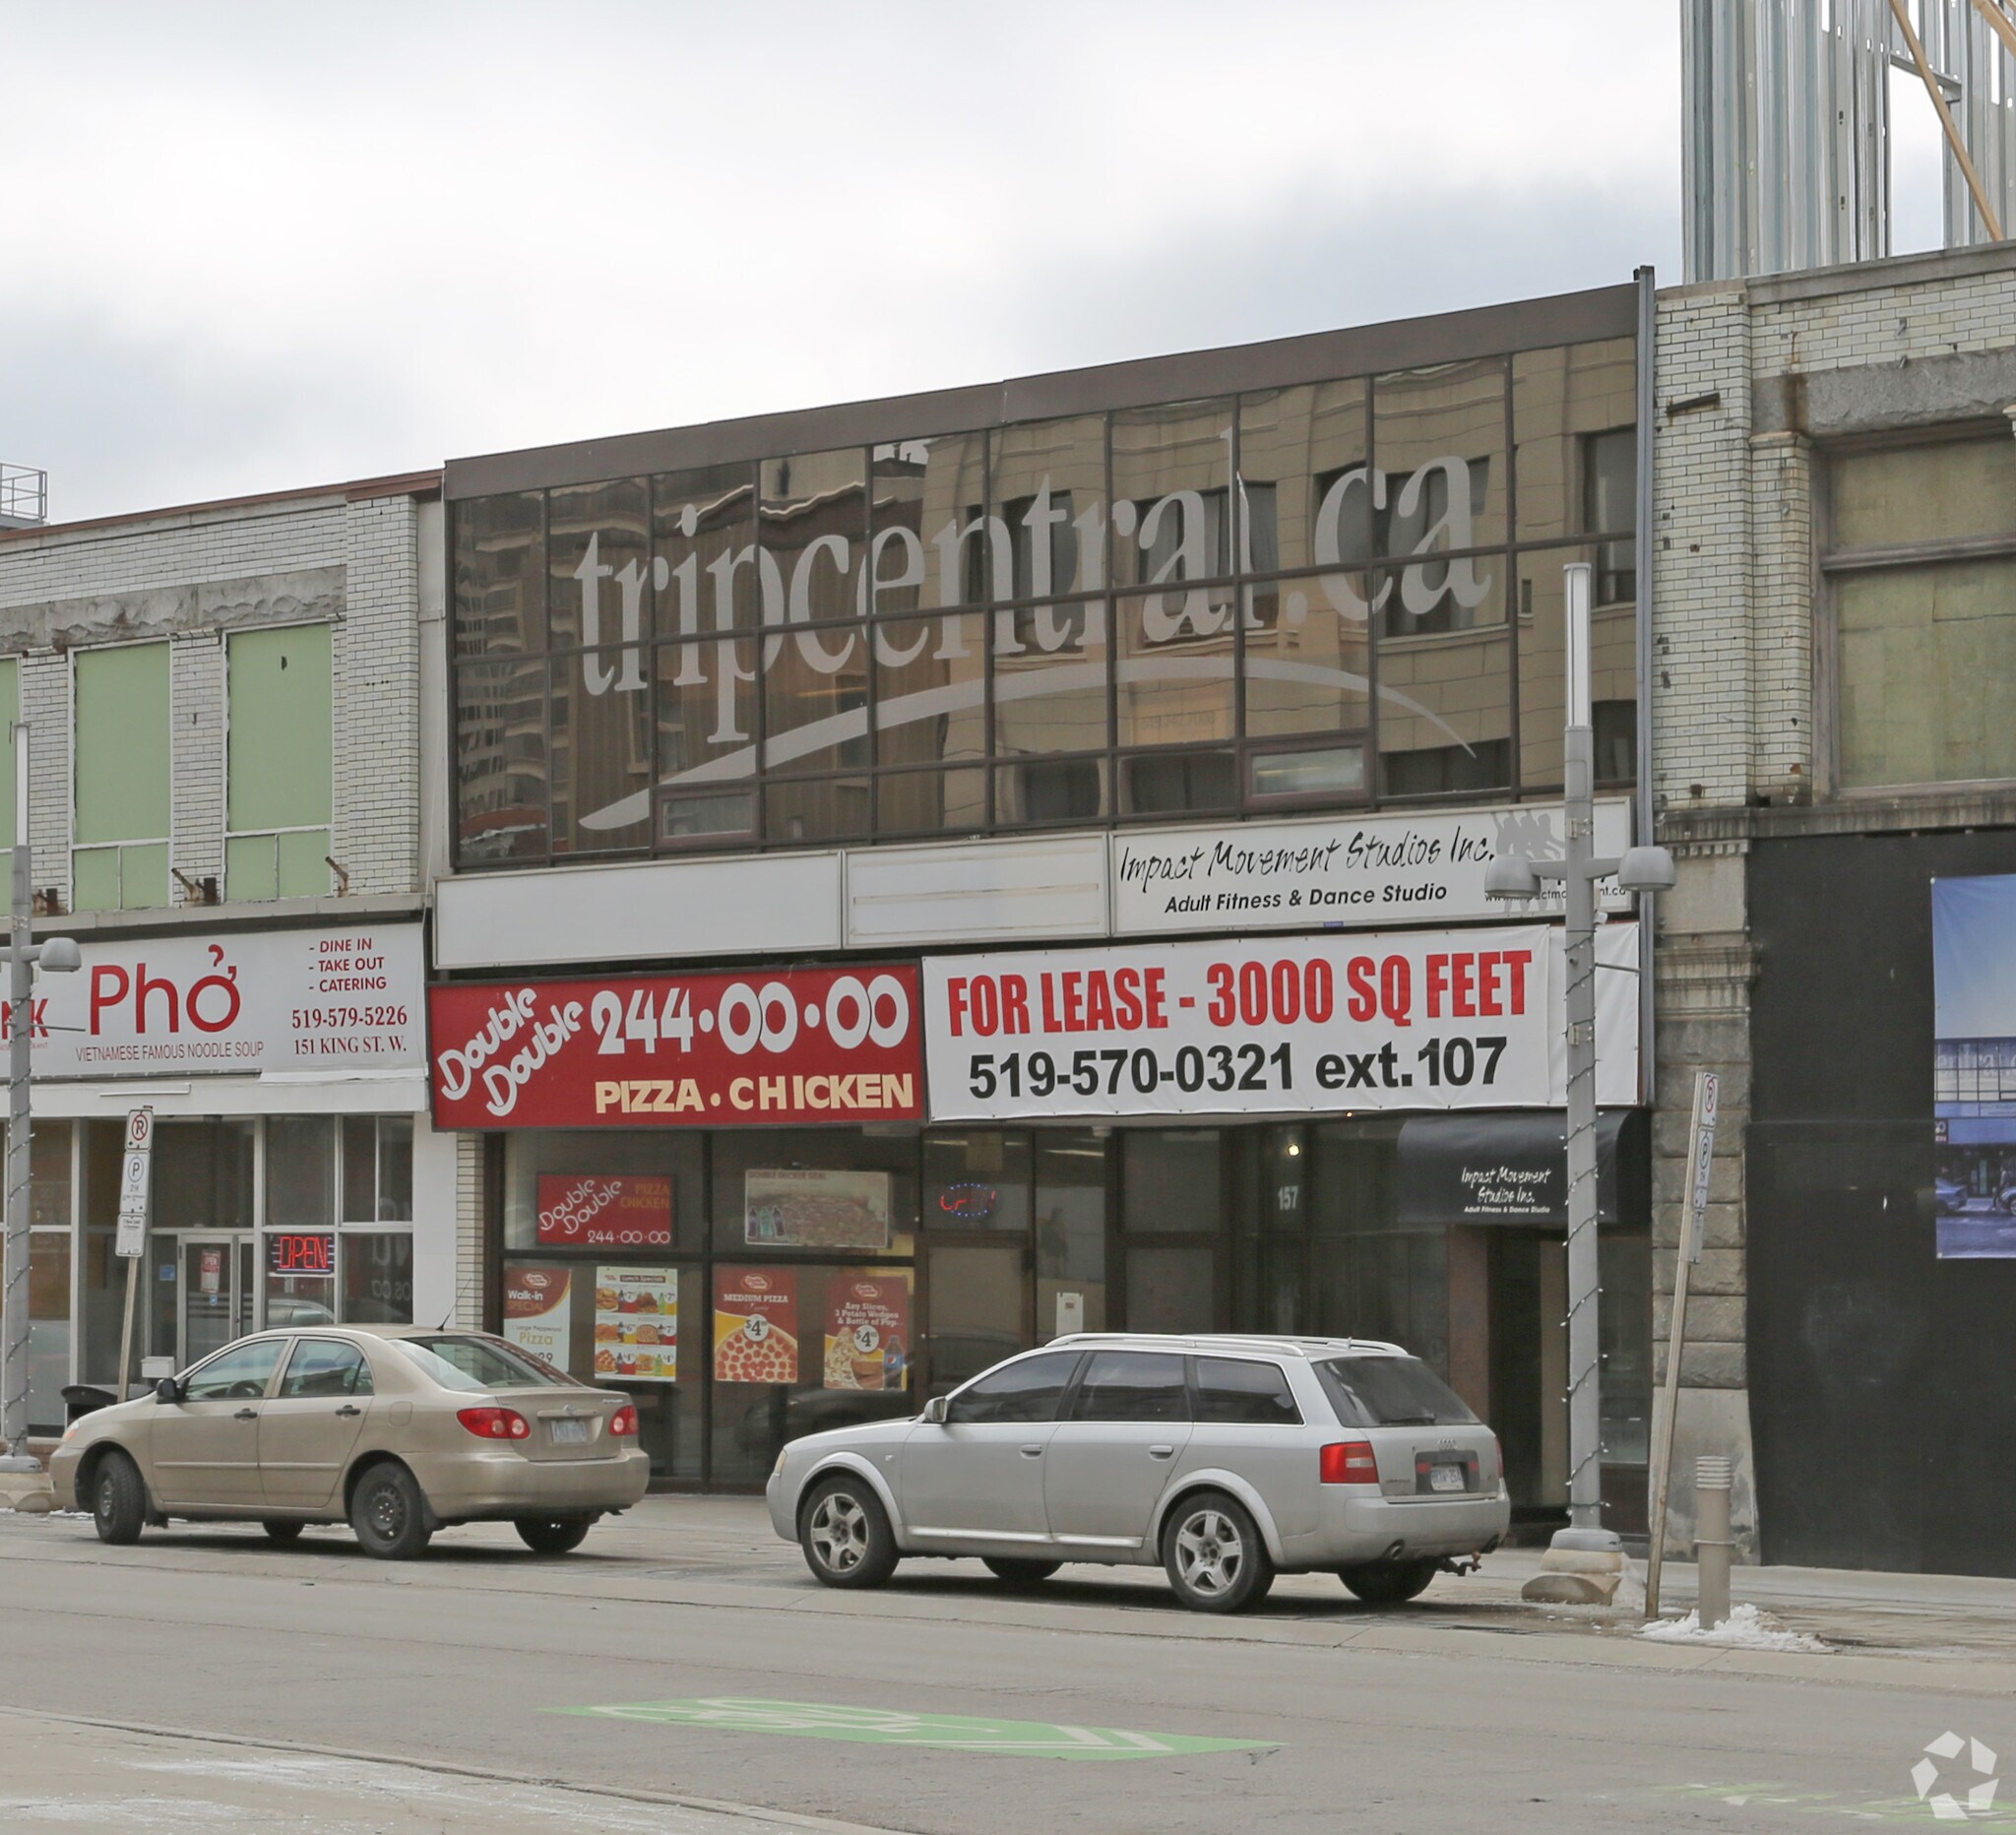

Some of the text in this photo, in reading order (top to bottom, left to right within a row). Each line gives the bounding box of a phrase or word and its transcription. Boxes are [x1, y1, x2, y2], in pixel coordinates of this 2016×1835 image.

[574, 425, 1492, 744] tripcentral.ca
[1120, 825, 1495, 893] Impact Movement Studios Inc.
[1165, 883, 1447, 914] Adult Fitness & Dance Studio
[319, 938, 352, 953] DINE
[356, 937, 373, 951] IN
[318, 958, 350, 973] TAKE
[354, 956, 385, 971] OUT
[90, 943, 241, 1035] Phở
[319, 976, 387, 992] CATERING
[947, 975, 1031, 1038] FOR
[1041, 967, 1168, 1034] LEASE
[1207, 957, 1334, 1027] 3000
[1347, 954, 1412, 1028] SQ
[1425, 949, 1534, 1019] FEET
[291, 1004, 409, 1029] 519-579-5226
[76, 1041, 264, 1061] VIETNAMESE FAMOUS NOODLE SOUP
[294, 1035, 408, 1055] 151 KING ST. W.
[437, 987, 537, 1102] Double
[481, 1000, 585, 1117] Double
[969, 1035, 1508, 1100] 519-570-0321 ext.107
[595, 1073, 914, 1114] PIZZA CHICKEN
[635, 1183, 669, 1195] PIZZA
[1461, 1166, 1551, 1189] Impact Movement
[538, 1179, 596, 1231] Double
[620, 1196, 669, 1209] CHICKEN
[1278, 1185, 1299, 1211] 157
[1478, 1185, 1536, 1203] Studios Inc.
[562, 1180, 622, 1234] Double
[279, 1235, 329, 1269] OPEN
[508, 1290, 543, 1301] Walk-in
[763, 1295, 788, 1303] PIZZA
[519, 1332, 553, 1346] Pizza
